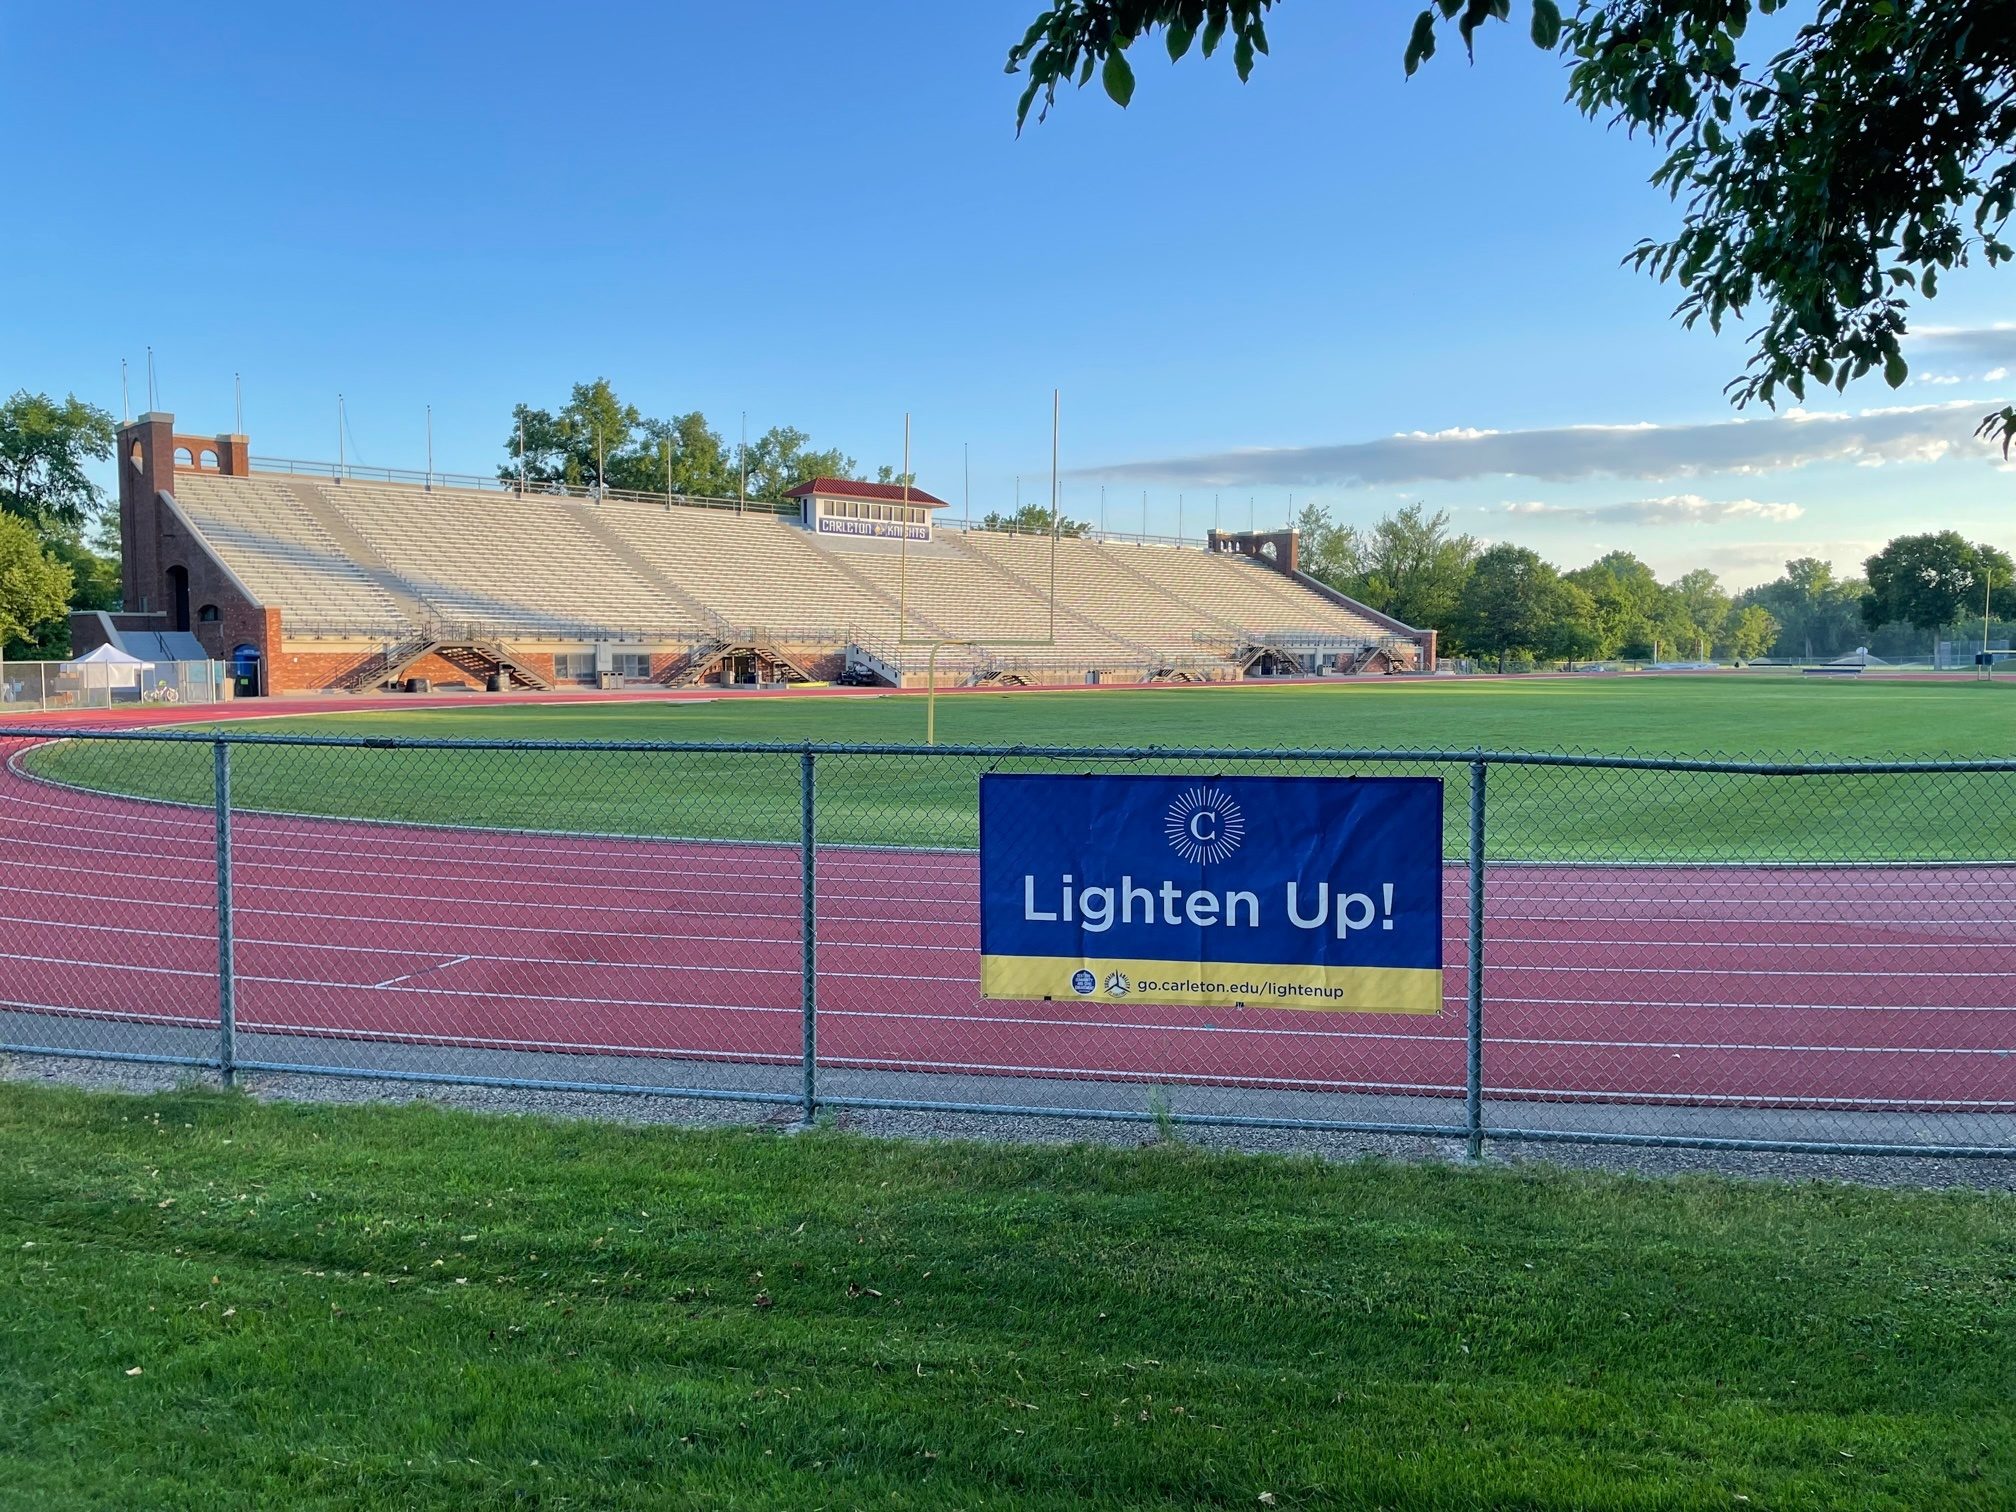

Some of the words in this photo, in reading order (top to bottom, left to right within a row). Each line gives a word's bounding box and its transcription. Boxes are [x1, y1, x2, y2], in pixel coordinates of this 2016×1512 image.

[822, 519, 872, 534] CARLETON
[1190, 811, 1216, 840] C
[1024, 874, 1260, 933] Lighten
[1286, 881, 1394, 940] Up!
[1137, 979, 1344, 999] go.carleton.edu/lightenup
